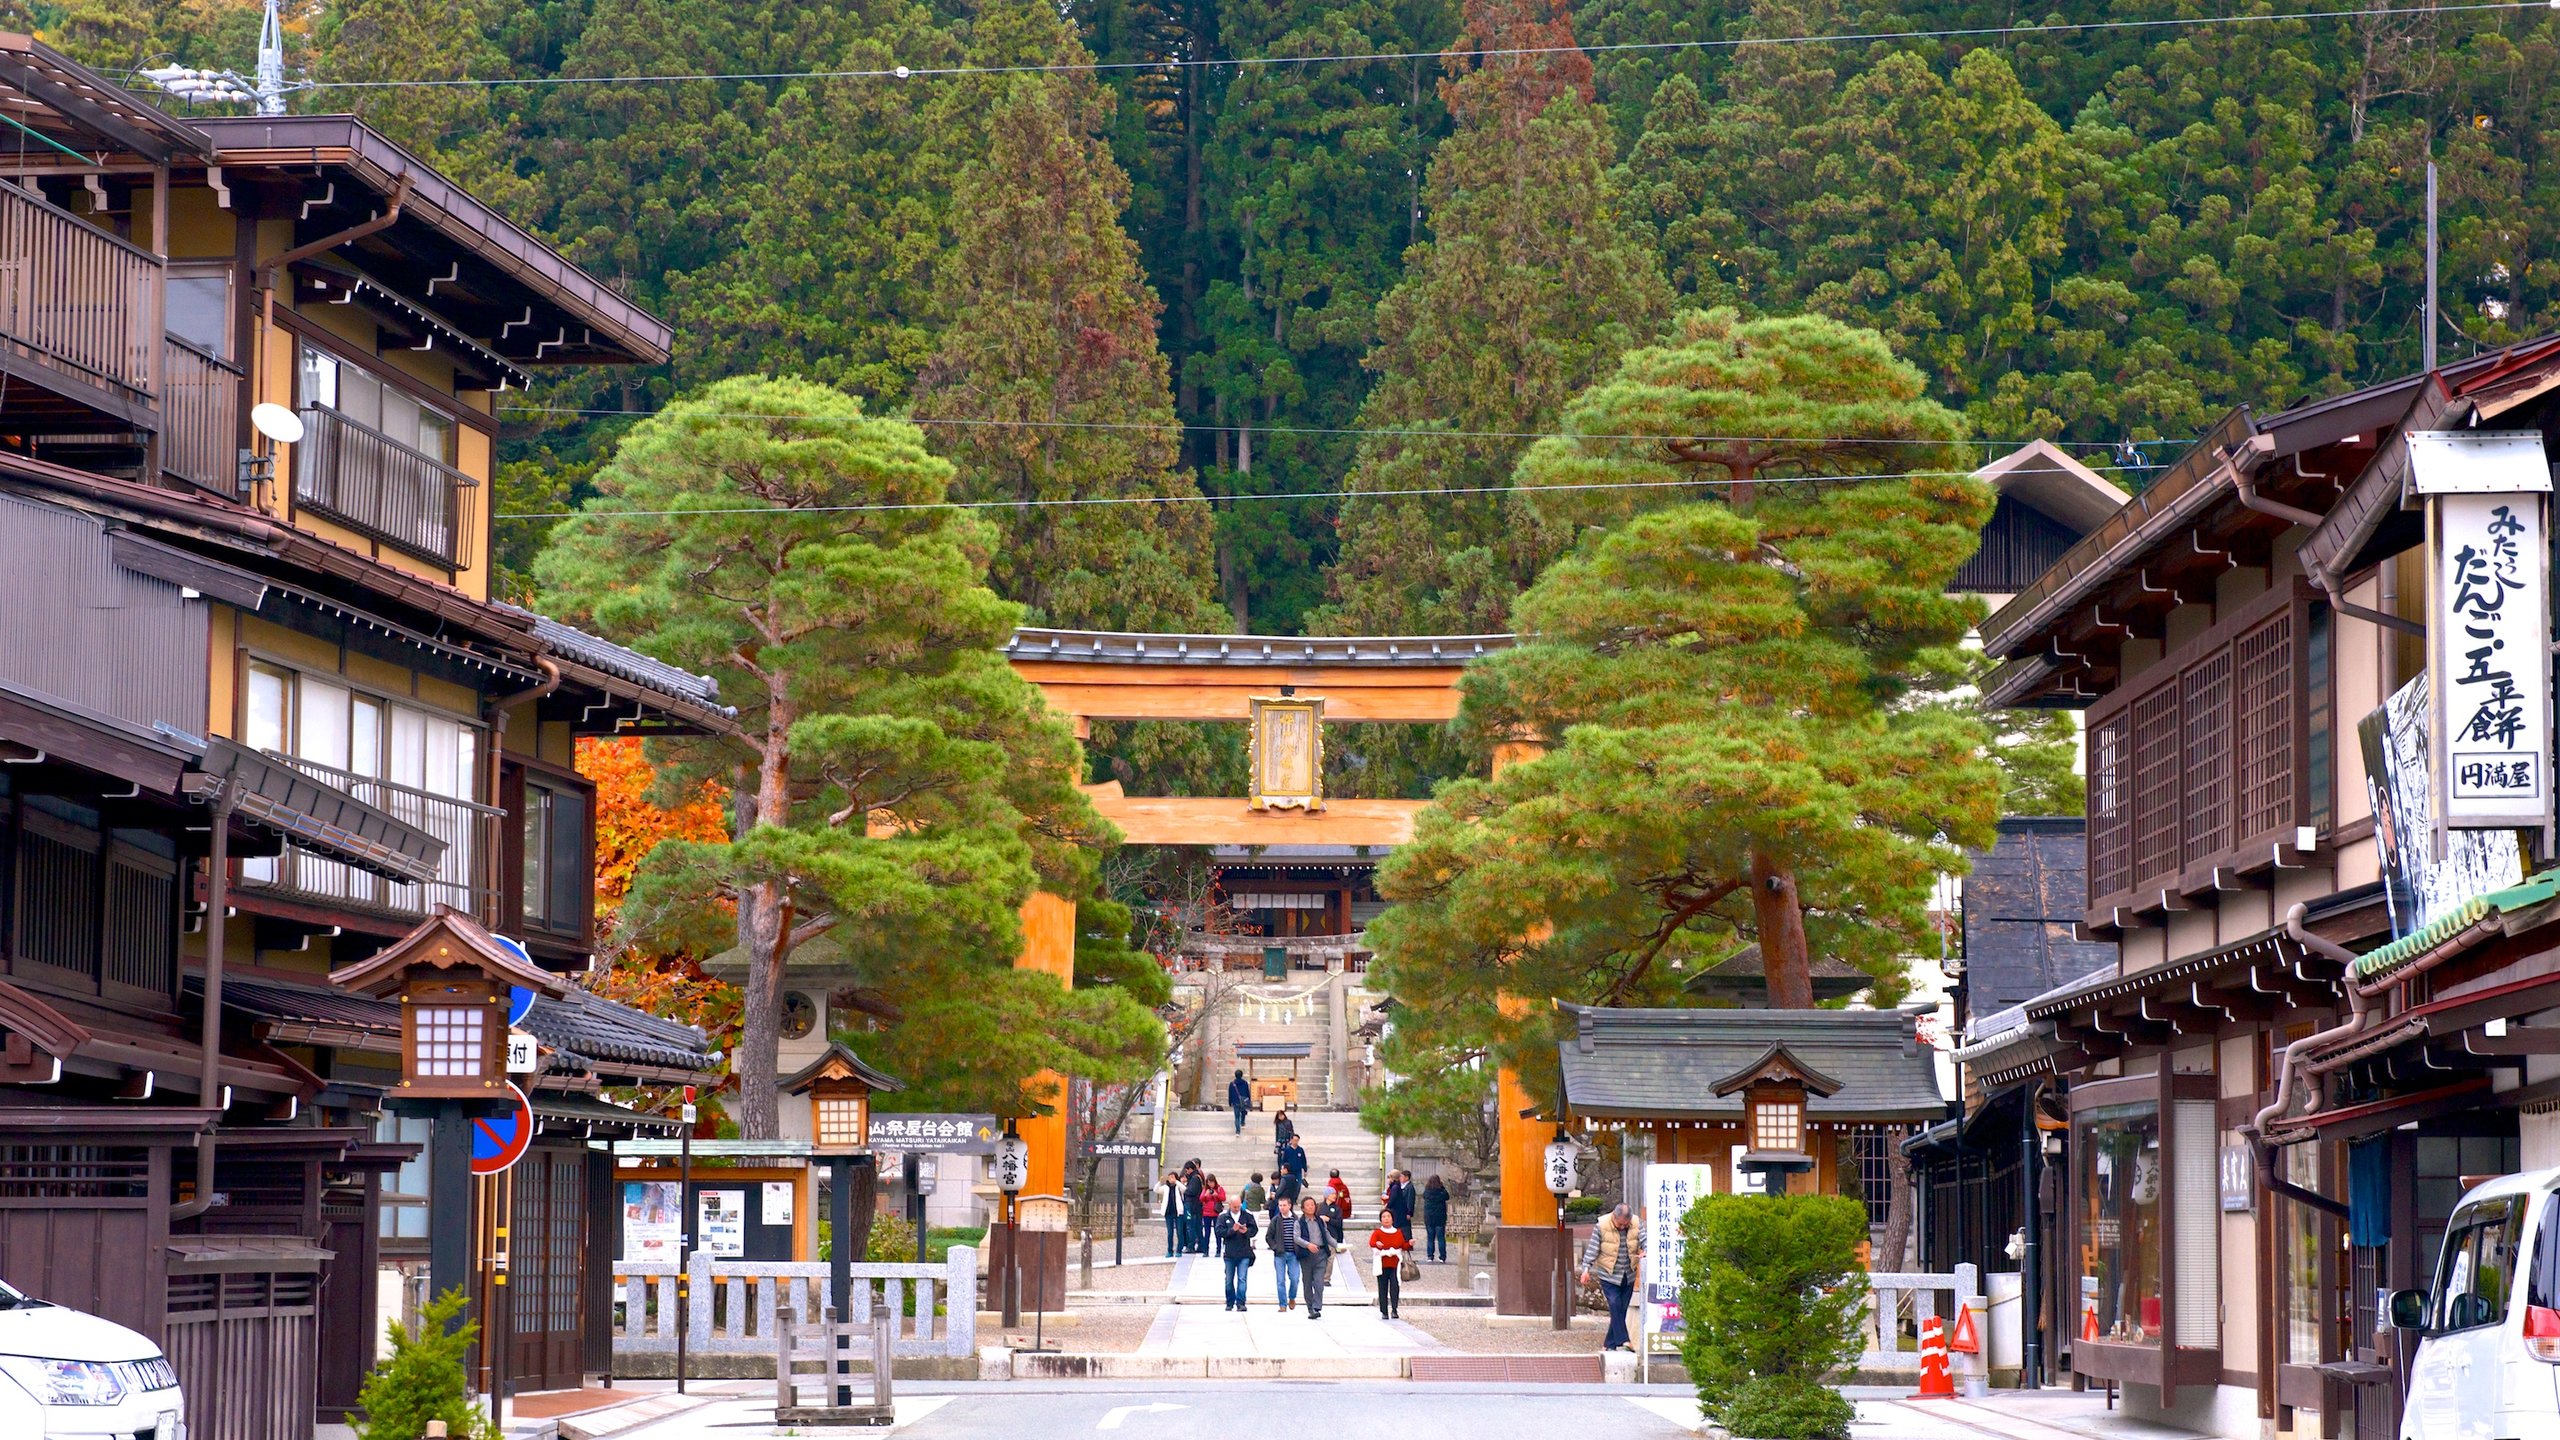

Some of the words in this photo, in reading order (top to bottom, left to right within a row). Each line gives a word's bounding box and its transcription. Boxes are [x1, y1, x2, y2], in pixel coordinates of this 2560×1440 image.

[2487, 505, 2526, 589] みたらし
[2461, 761, 2531, 789] 円満屋
[868, 1119, 974, 1137] 山祭屋台会館
